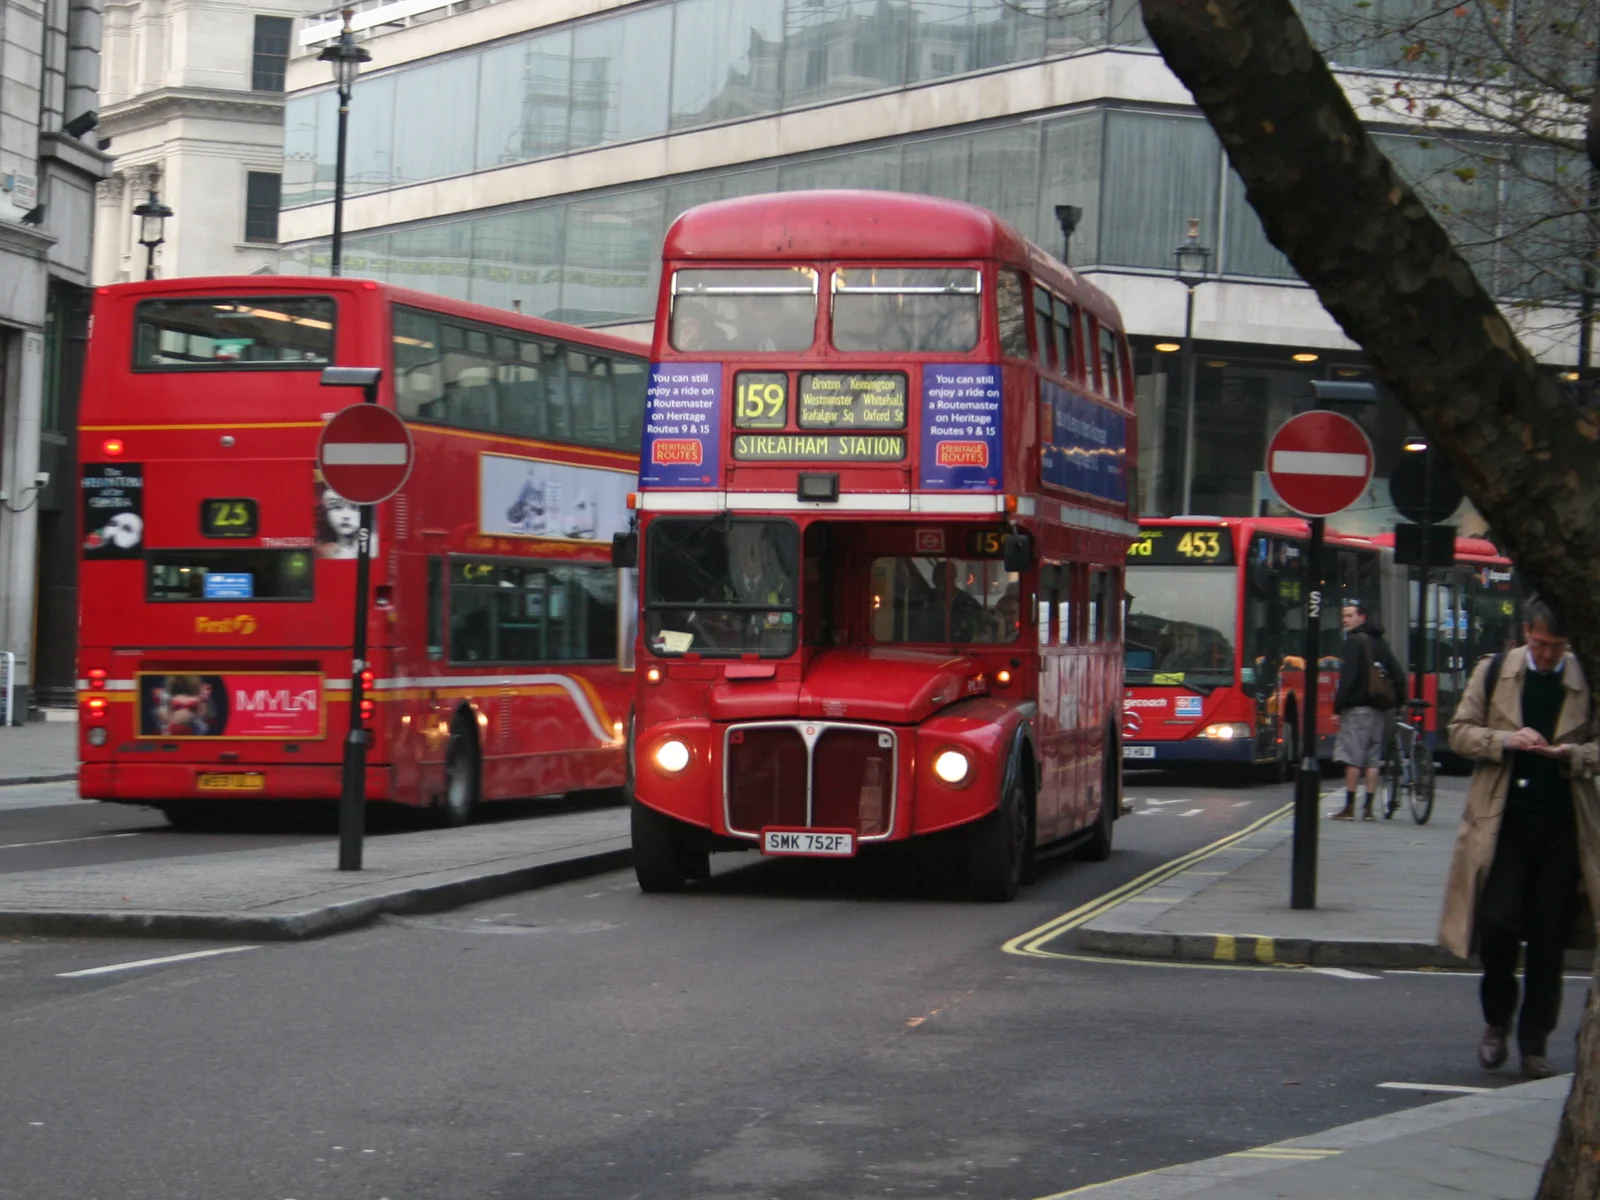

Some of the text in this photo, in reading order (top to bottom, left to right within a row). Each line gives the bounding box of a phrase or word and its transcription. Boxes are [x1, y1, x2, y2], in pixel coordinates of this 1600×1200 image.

[653, 374, 670, 382] You
[691, 373, 709, 382] still
[936, 374, 994, 384] You can still
[812, 377, 896, 392] Brixton Kennington
[647, 387, 671, 397] enjoy
[681, 386, 699, 395] ride
[928, 388, 955, 398] enjoy
[965, 387, 984, 397] ride
[986, 389, 1000, 398] on
[653, 399, 713, 408] Routemaster
[738, 383, 785, 418] 159
[803, 393, 904, 406] Westminster Whitehall
[937, 400, 999, 410] Routemaster
[651, 411, 706, 422] on Heritage
[802, 409, 904, 423] Trafalgar Sq Oxford St
[935, 413, 992, 424] on Heritage
[647, 425, 710, 434] Routes 9 & 15
[930, 426, 996, 436] Routes 9 & 15
[657, 442, 697, 451] HERITAGE
[738, 436, 900, 456] STREATHAM STATION
[941, 444, 983, 453] HERITAGE
[657, 451, 698, 461] ROUTES
[941, 453, 984, 463] ROUTES
[1176, 532, 1220, 557] 453
[1309, 590, 1321, 617] S2
[236, 690, 317, 711] MYLA
[770, 834, 844, 850] SMK 752F
